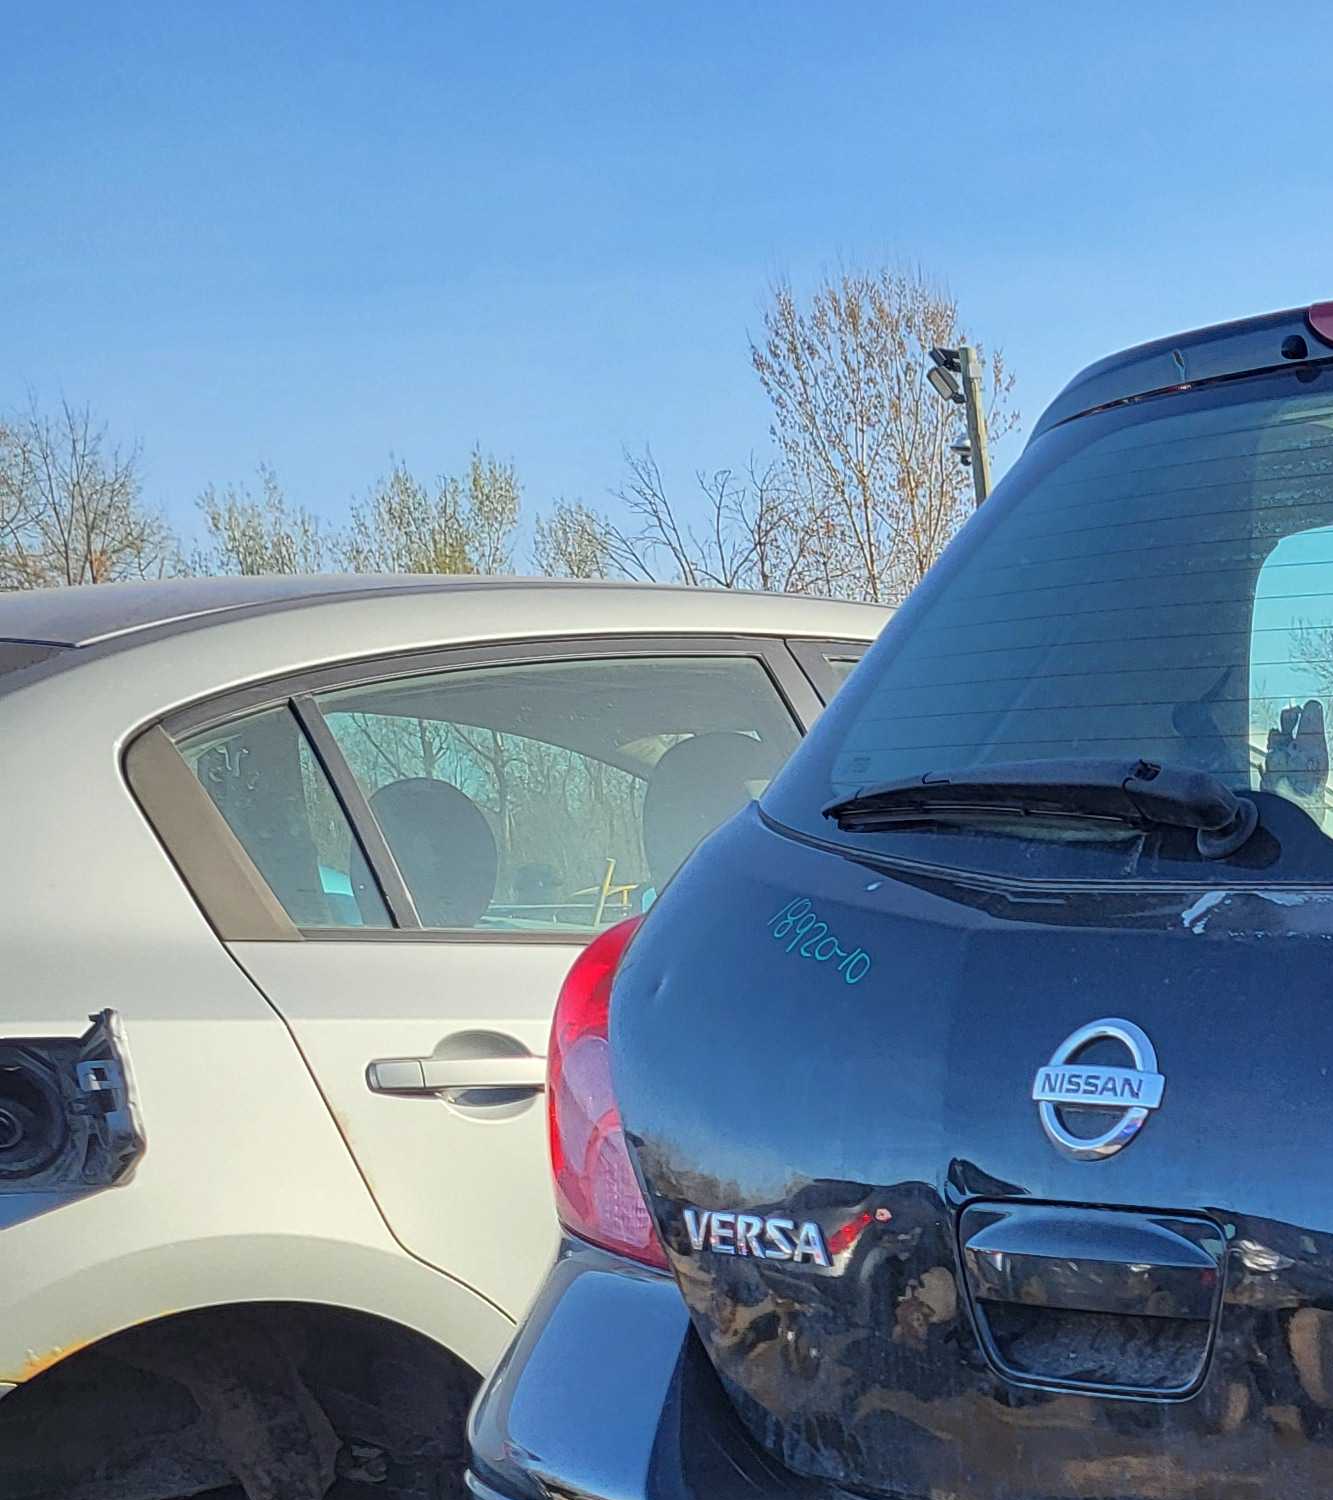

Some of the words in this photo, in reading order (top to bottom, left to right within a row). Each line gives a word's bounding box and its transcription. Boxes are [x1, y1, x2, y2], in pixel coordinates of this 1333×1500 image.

[767, 896, 871, 984] 18920-10
[1041, 1072, 1144, 1100] NISSAN
[683, 1207, 833, 1268] VERSA
